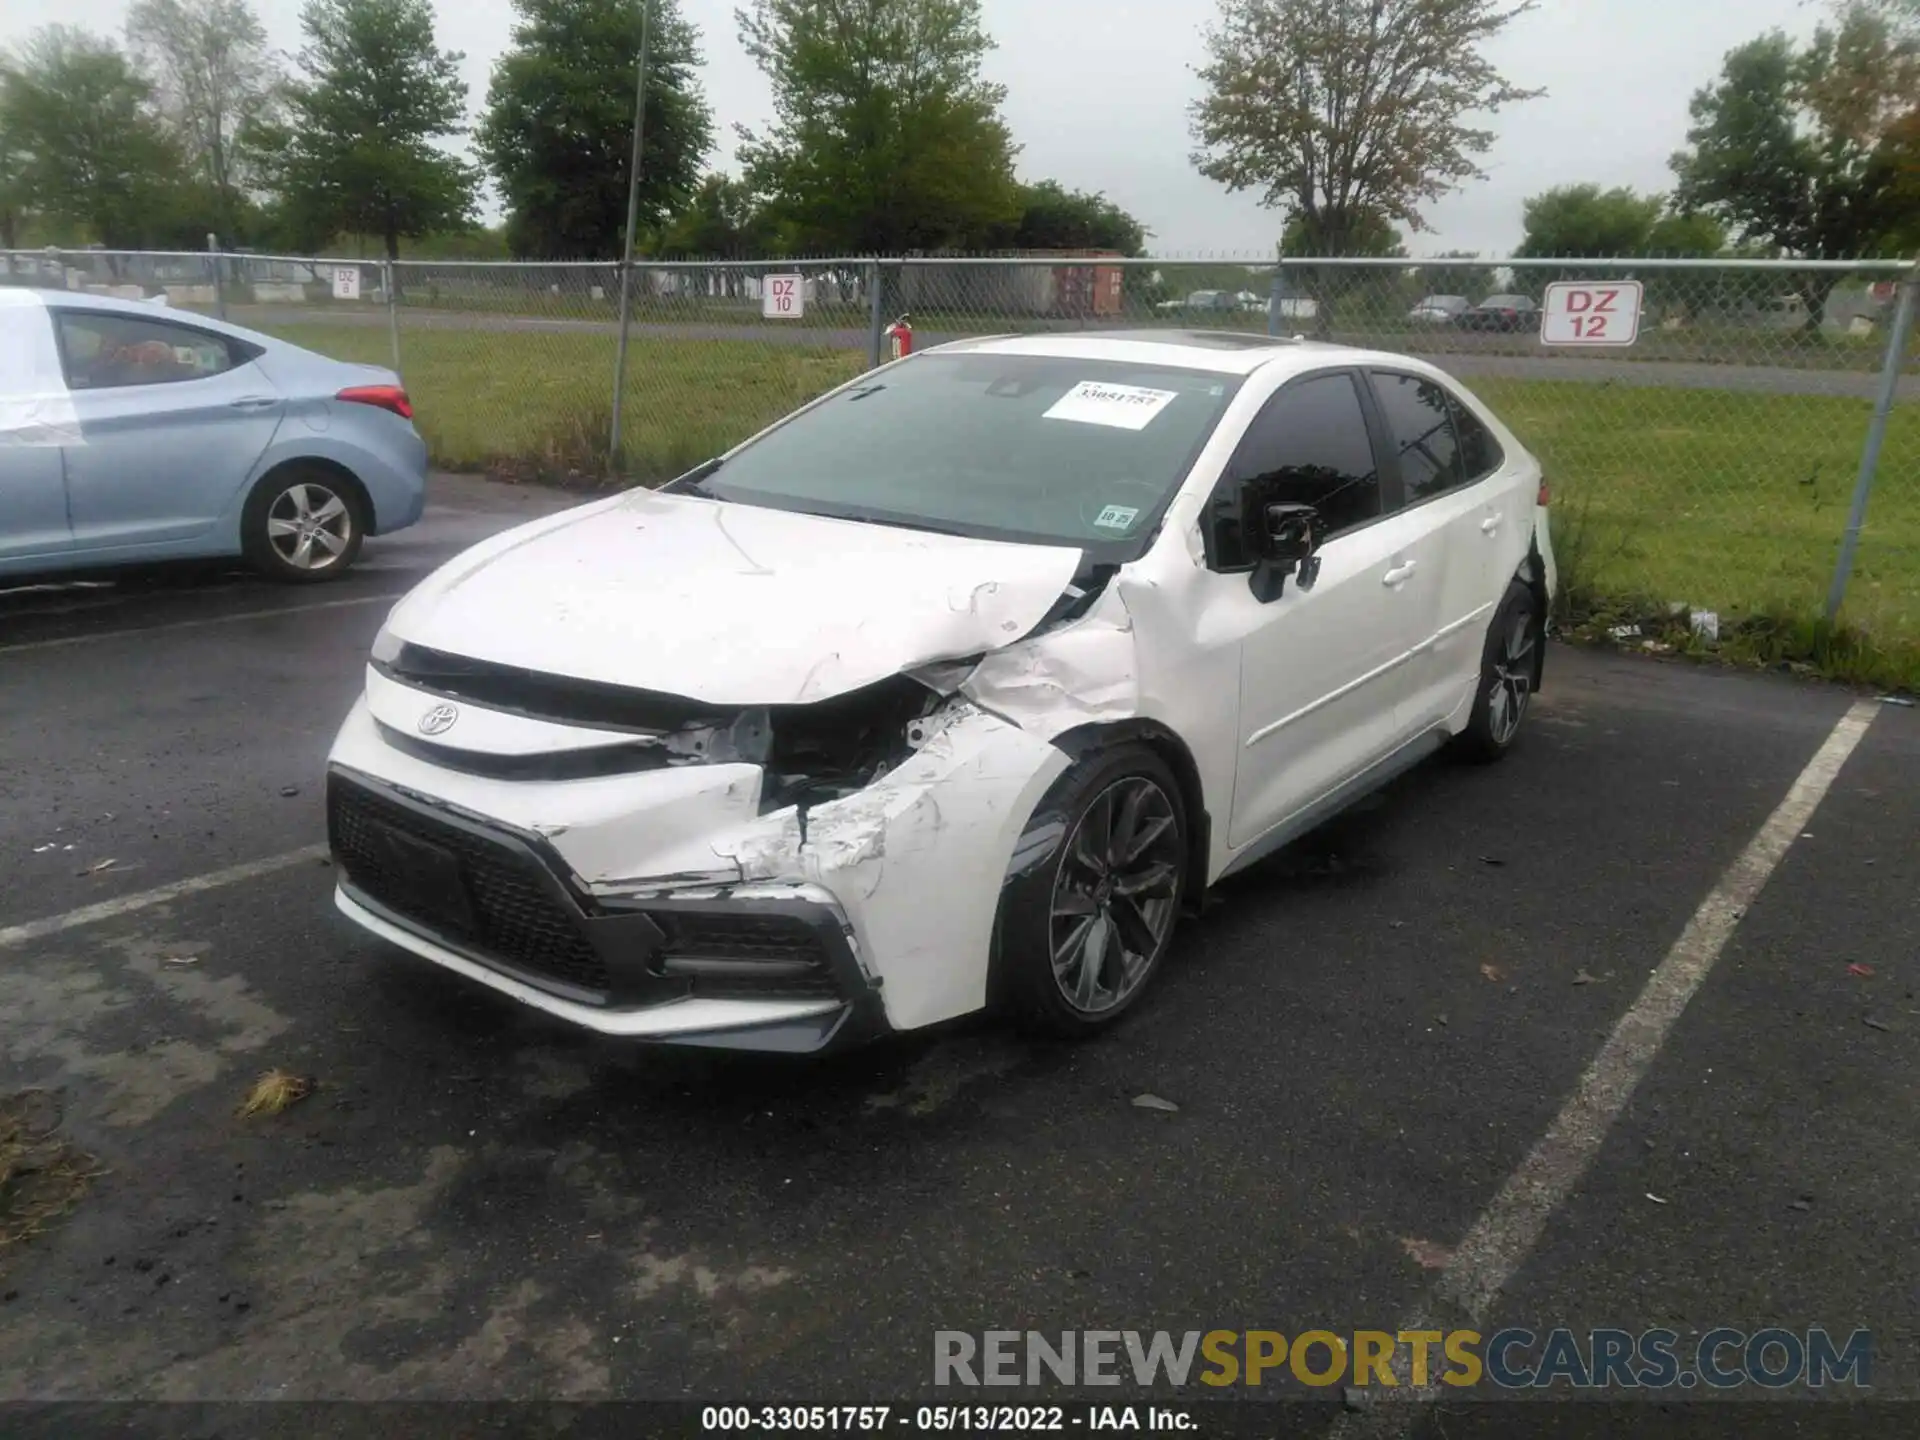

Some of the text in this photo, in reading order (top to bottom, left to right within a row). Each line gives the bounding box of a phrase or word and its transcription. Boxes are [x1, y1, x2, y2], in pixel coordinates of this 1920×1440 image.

[339, 270, 354, 282] DZ
[773, 280, 795, 296] DZ
[776, 296, 791, 311] 10
[1566, 290, 1619, 312] DZ
[1569, 315, 1607, 337] 12
